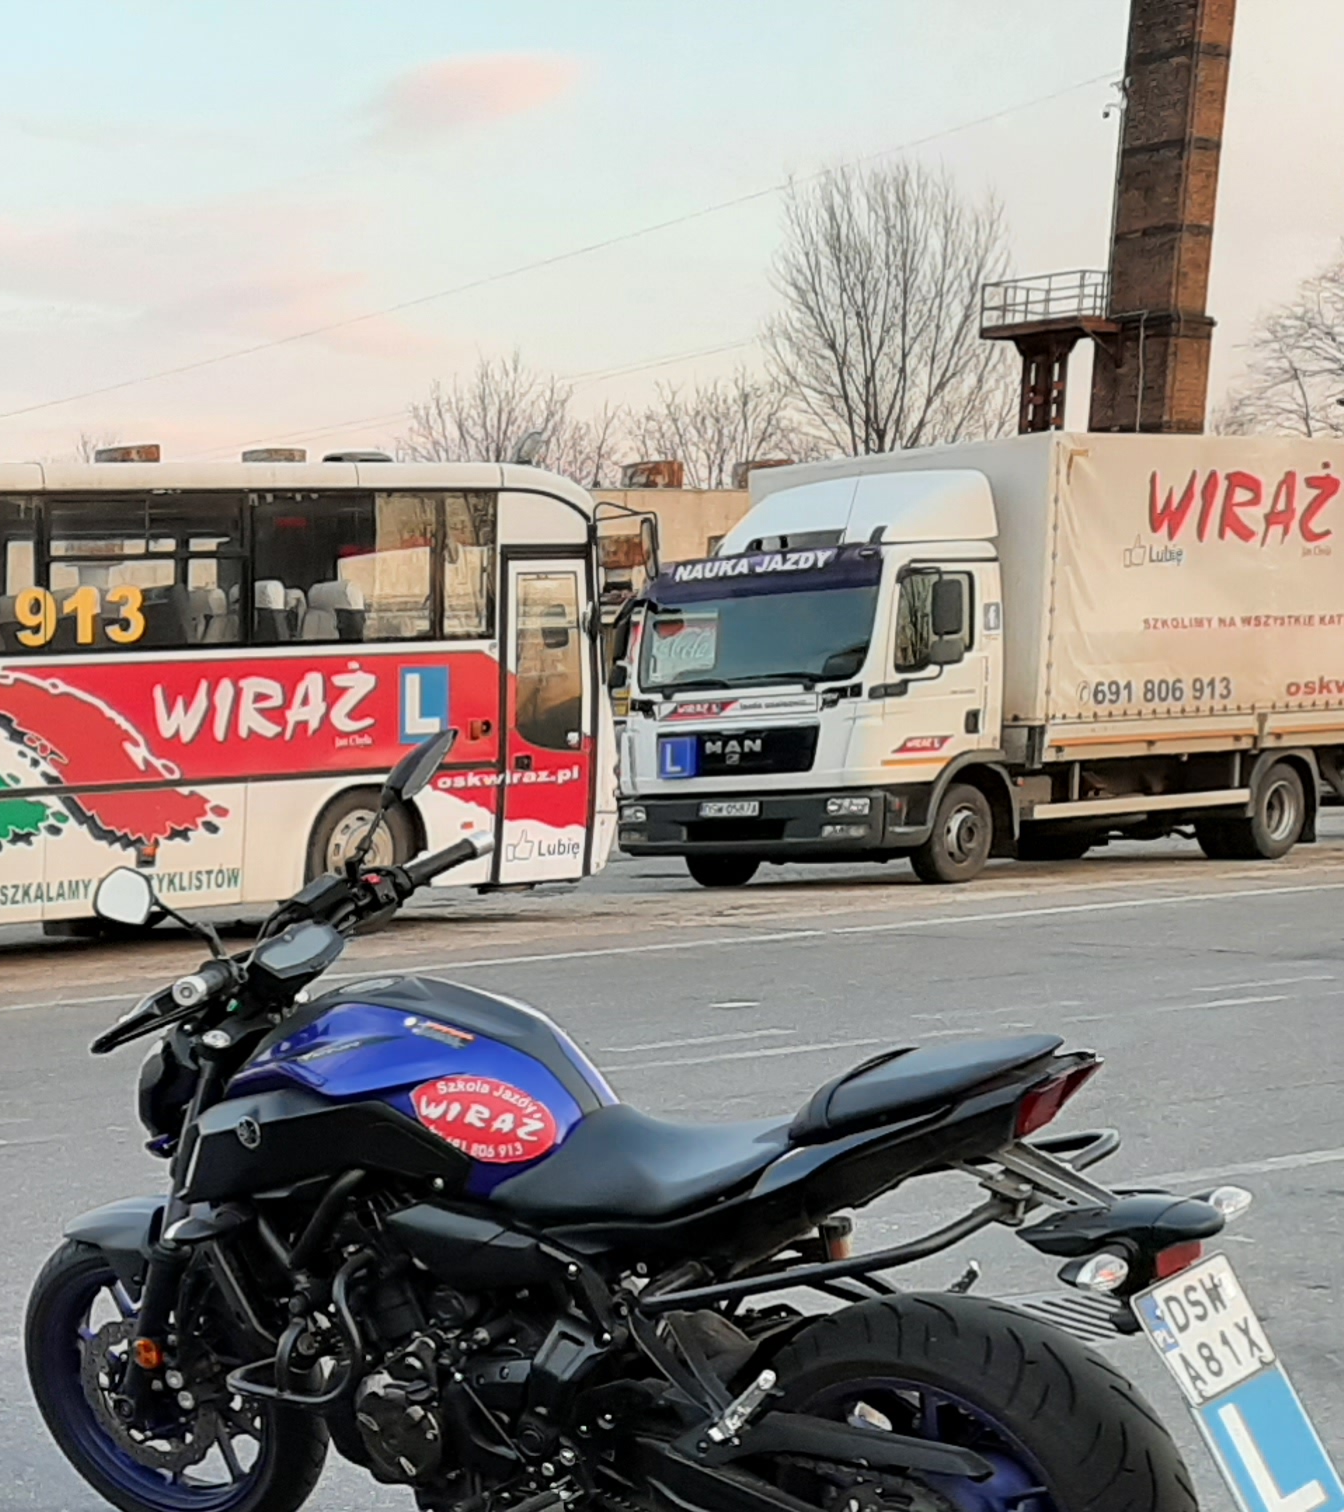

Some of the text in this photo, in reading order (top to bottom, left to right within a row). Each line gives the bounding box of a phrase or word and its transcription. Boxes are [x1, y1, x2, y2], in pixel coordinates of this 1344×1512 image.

[1149, 461, 1341, 547] WIRAŻ
[674, 550, 832, 582] NAUKA JAZDY
[15, 585, 147, 647] 913
[1143, 617, 1212, 631] SZKOLIMY
[1218, 616, 1236, 628] NA
[1241, 614, 1314, 628] WSZYSTKIE
[153, 660, 376, 743] WIRAŻ
[405, 673, 440, 734] L
[1093, 677, 1232, 705] 691 806 913
[665, 743, 682, 773] L
[705, 739, 762, 754] MAN
[437, 766, 580, 789] oskwiraz.pl
[538, 839, 580, 859] Lubię
[493, 1085, 537, 1114] Jazdy
[420, 1096, 545, 1141] WIRAŻ
[471, 1143, 496, 1158] 806
[498, 1141, 524, 1157] 913
[1163, 1272, 1227, 1334] DSW
[1153, 1328, 1175, 1349] PL
[1178, 1316, 1263, 1391] A81X
